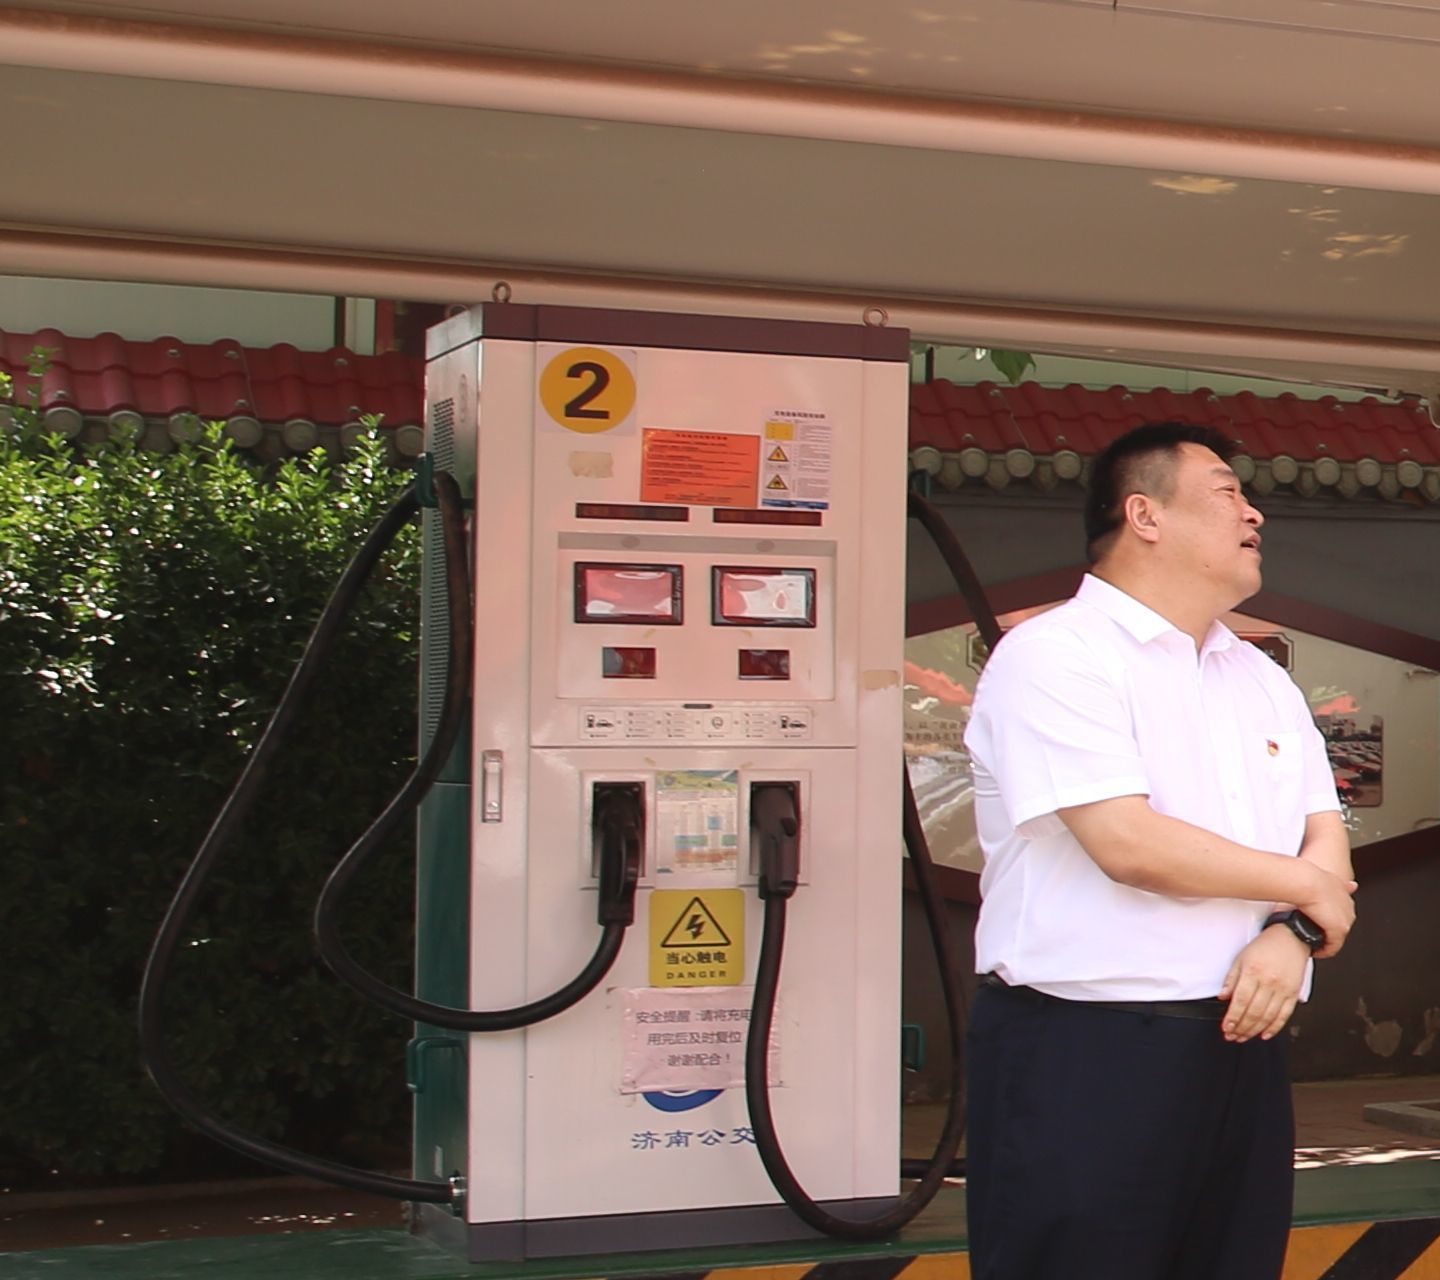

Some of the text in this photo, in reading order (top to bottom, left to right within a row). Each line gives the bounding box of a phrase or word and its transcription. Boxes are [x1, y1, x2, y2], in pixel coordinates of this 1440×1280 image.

[559, 361, 611, 419] 2
[666, 951, 728, 965] 当心触电
[666, 971, 727, 980] DANGER
